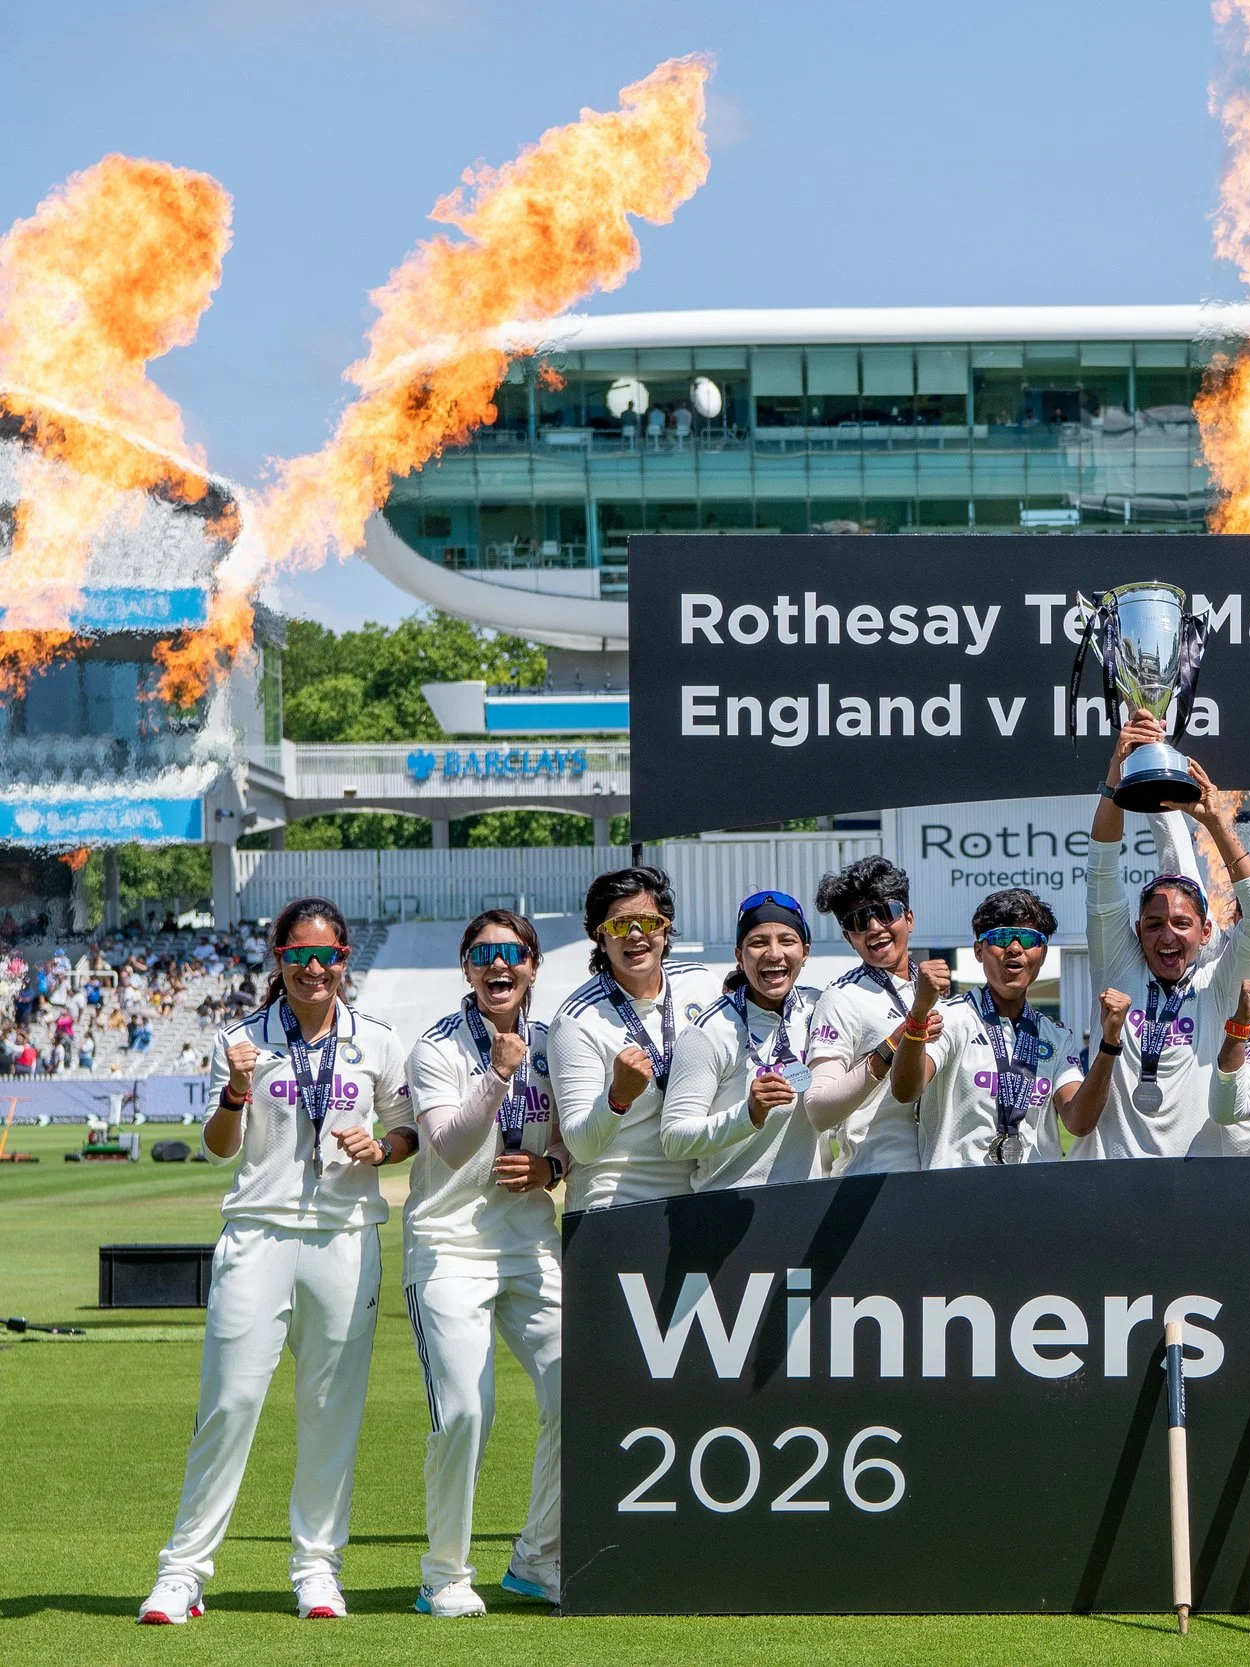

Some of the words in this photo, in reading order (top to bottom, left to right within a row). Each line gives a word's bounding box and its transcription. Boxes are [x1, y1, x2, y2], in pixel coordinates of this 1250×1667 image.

[680, 592, 1001, 655] Rothesay
[1025, 593, 1110, 646] Te
[681, 683, 962, 747] England
[988, 697, 1026, 736] v
[1054, 685, 1220, 736] Inia
[444, 749, 588, 777] BARCLAYS
[921, 822, 1158, 859] Rothea
[951, 867, 1064, 891] Protecting
[624, 1001, 636, 1018] MATCH
[327, 1036, 337, 1070] Rothesay
[995, 1024, 1007, 1058] Rothesay
[1013, 1029, 1025, 1060] Rothesay
[1155, 1023, 1171, 1055] Rothesay
[1164, 1034, 1194, 1047] RES
[291, 1041, 303, 1074] Rothesay
[321, 1083, 331, 1118] Rothesay
[1014, 1076, 1029, 1109] Rothesay
[517, 1095, 526, 1129] Rothesay
[525, 1111, 550, 1123] RES
[617, 1267, 1225, 1380] Winners
[617, 1425, 906, 1513] 2026
